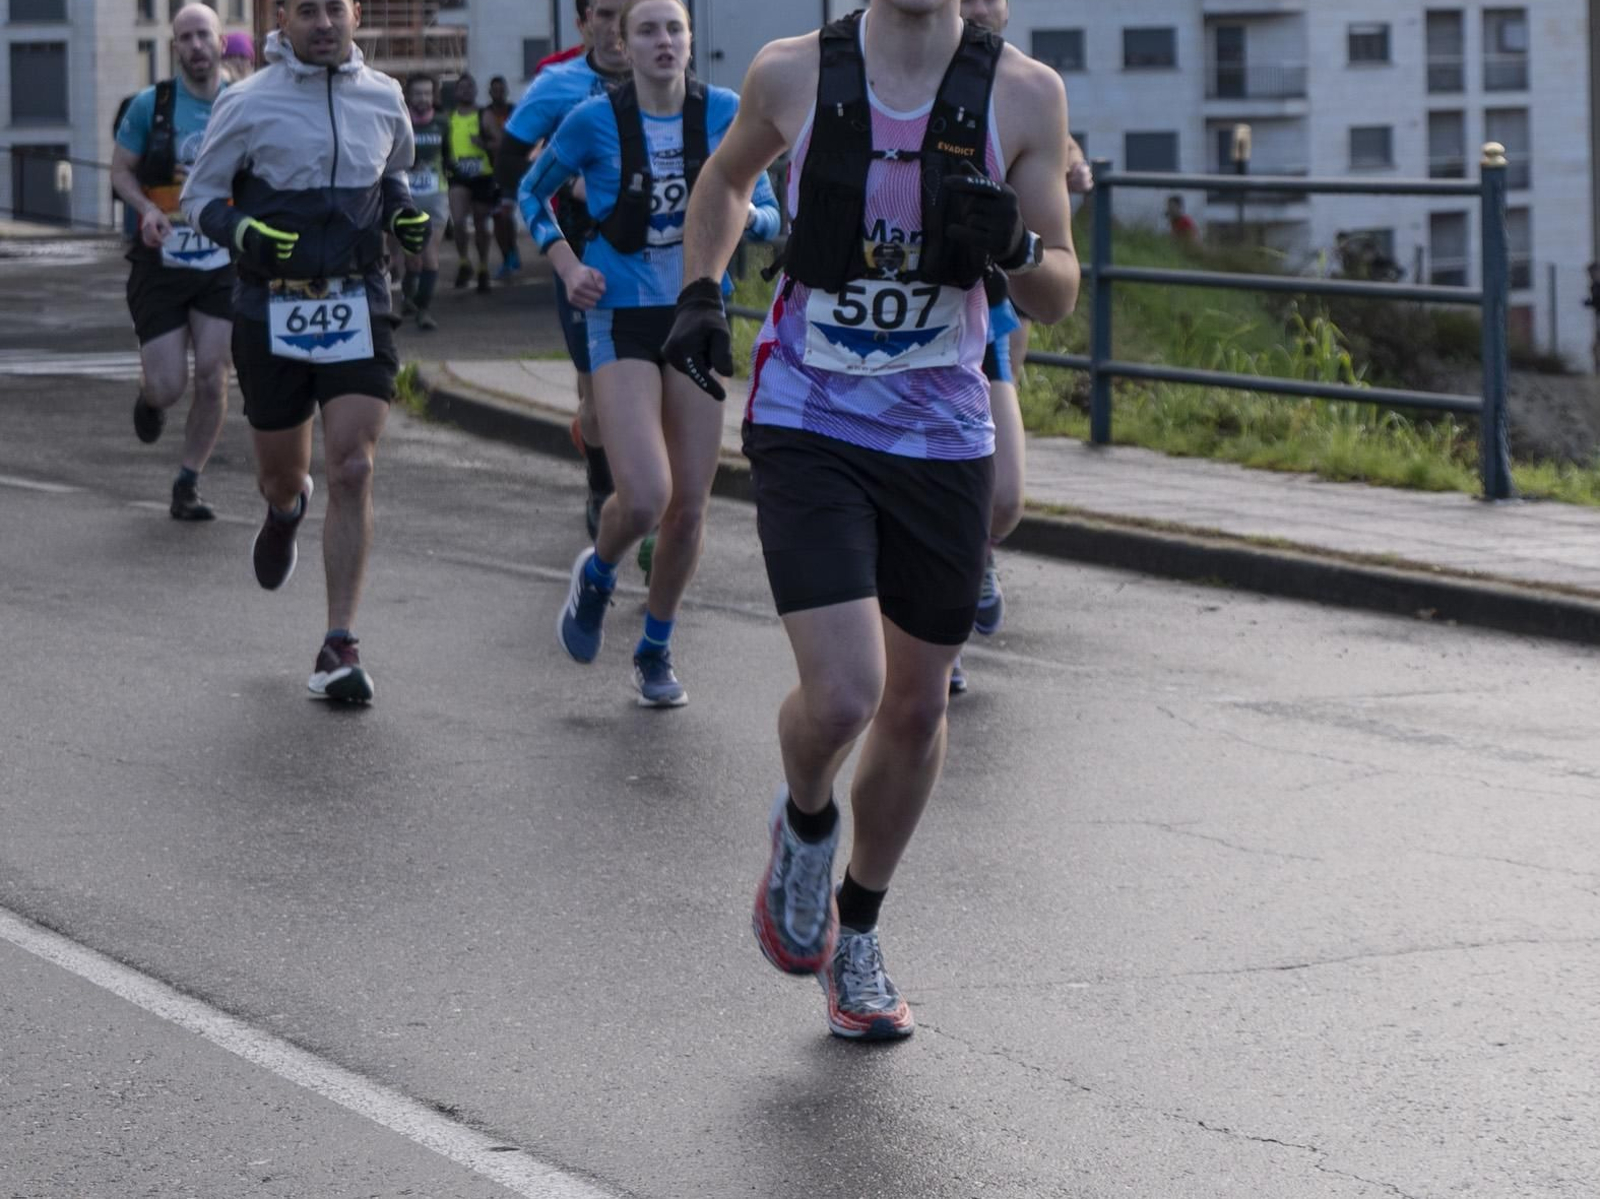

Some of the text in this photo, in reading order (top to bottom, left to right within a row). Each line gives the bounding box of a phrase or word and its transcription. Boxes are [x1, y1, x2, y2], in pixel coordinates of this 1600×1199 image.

[937, 141, 976, 156] EVADICT
[286, 303, 353, 333] 649
[832, 284, 941, 329] 507
